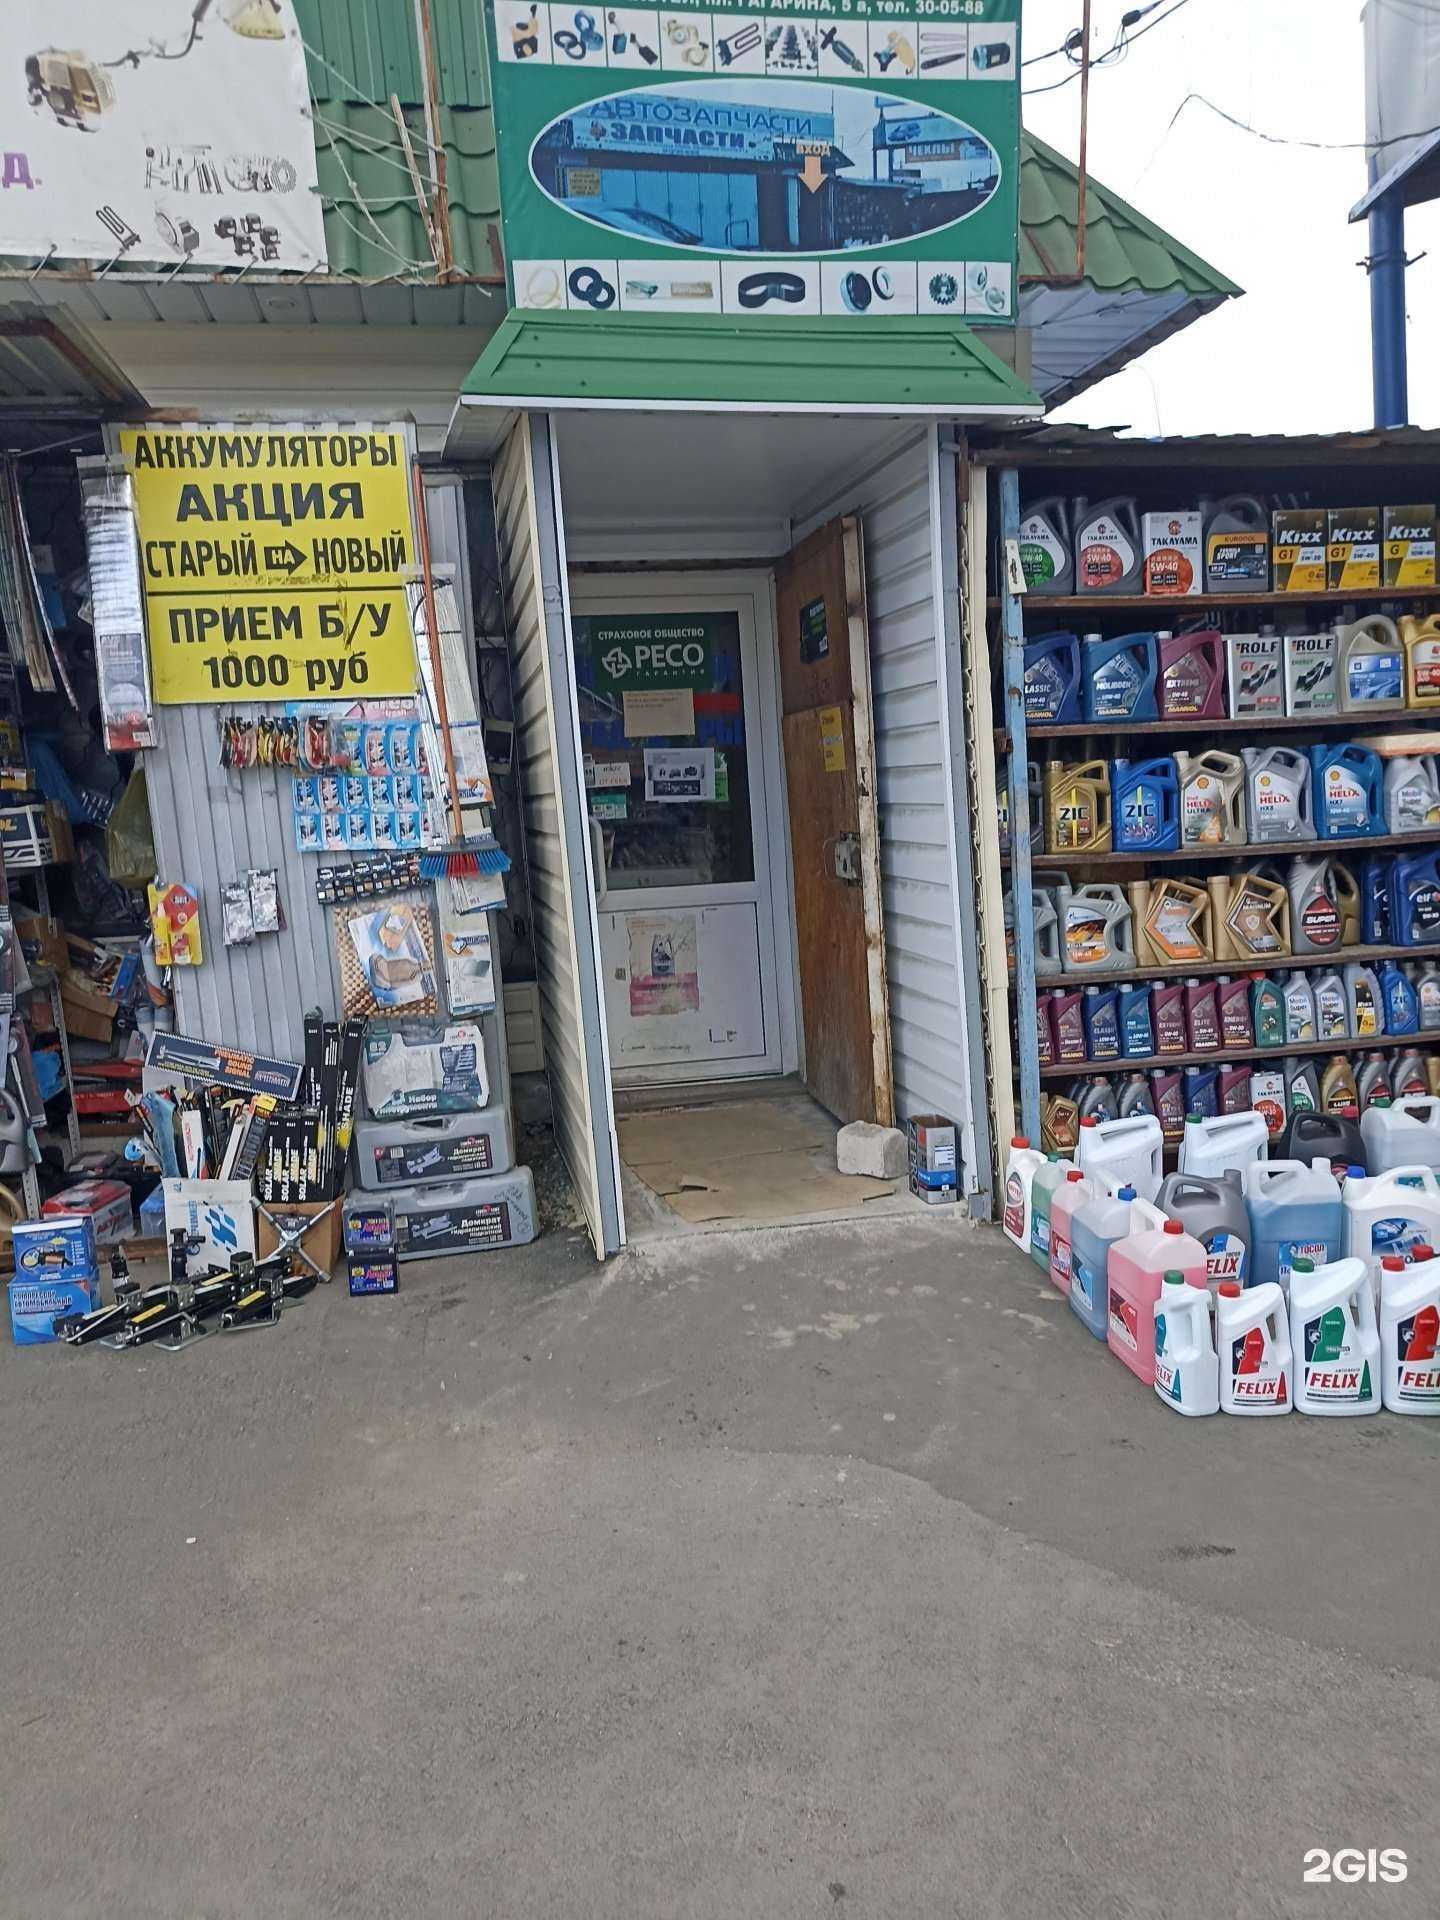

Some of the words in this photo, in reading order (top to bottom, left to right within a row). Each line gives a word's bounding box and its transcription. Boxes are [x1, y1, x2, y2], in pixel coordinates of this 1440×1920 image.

[876, 3, 911, 14] тел.
[915, 2, 985, 16] 30-05-88
[591, 99, 812, 135] АВТОЗАПЧАСТИ
[610, 122, 746, 148] ЗАПЧАСТИ
[135, 435, 398, 468] АККУМУЛЯТОРЫ
[176, 482, 365, 527] АКЦИЯ
[1279, 530, 1322, 543] Kixx
[1331, 528, 1373, 542] Kixx
[1389, 525, 1431, 539] Kixx
[1151, 536, 1198, 546] TAKAYAMA
[145, 532, 258, 577] СТАРЫЙ
[272, 550, 296, 566] НА
[312, 530, 406, 574] НОВЫЙ
[1278, 550, 1294, 561] G1
[1330, 546, 1347, 558] G1
[1389, 544, 1400, 555] G
[1150, 562, 1178, 572] 5W-40
[168, 605, 304, 644] ПРИЕМ
[318, 603, 392, 651] Б/У
[598, 629, 652, 641] СТРАХОВОЕ
[654, 627, 705, 640] ОБЩЕСТВО
[1240, 640, 1279, 654] ROLF
[1296, 638, 1334, 651] ROLF
[635, 643, 704, 668] РЕСО
[202, 653, 290, 689] 1000
[305, 651, 369, 692] руб
[1240, 660, 1255, 673] GT
[1025, 683, 1051, 694] LASSIC
[1259, 793, 1291, 804] HELIX
[1329, 788, 1361, 799] HELIX
[1060, 806, 1089, 821] ZIC
[1125, 803, 1155, 818] ZIC
[1416, 893, 1431, 904] elf
[1306, 915, 1336, 924] SUPER
[408, 1094, 437, 1103] Набор
[342, 1087, 354, 1128] SHADE
[453, 1146, 485, 1156] Домкрат
[265, 1168, 273, 1201] SOLAR
[282, 1169, 290, 1202] SOLAR
[299, 1168, 307, 1201] SOLAR
[461, 1216, 502, 1228] Домкрат
[1309, 1372, 1359, 1389] FELIX
[1236, 1381, 1276, 1395] FELIX
